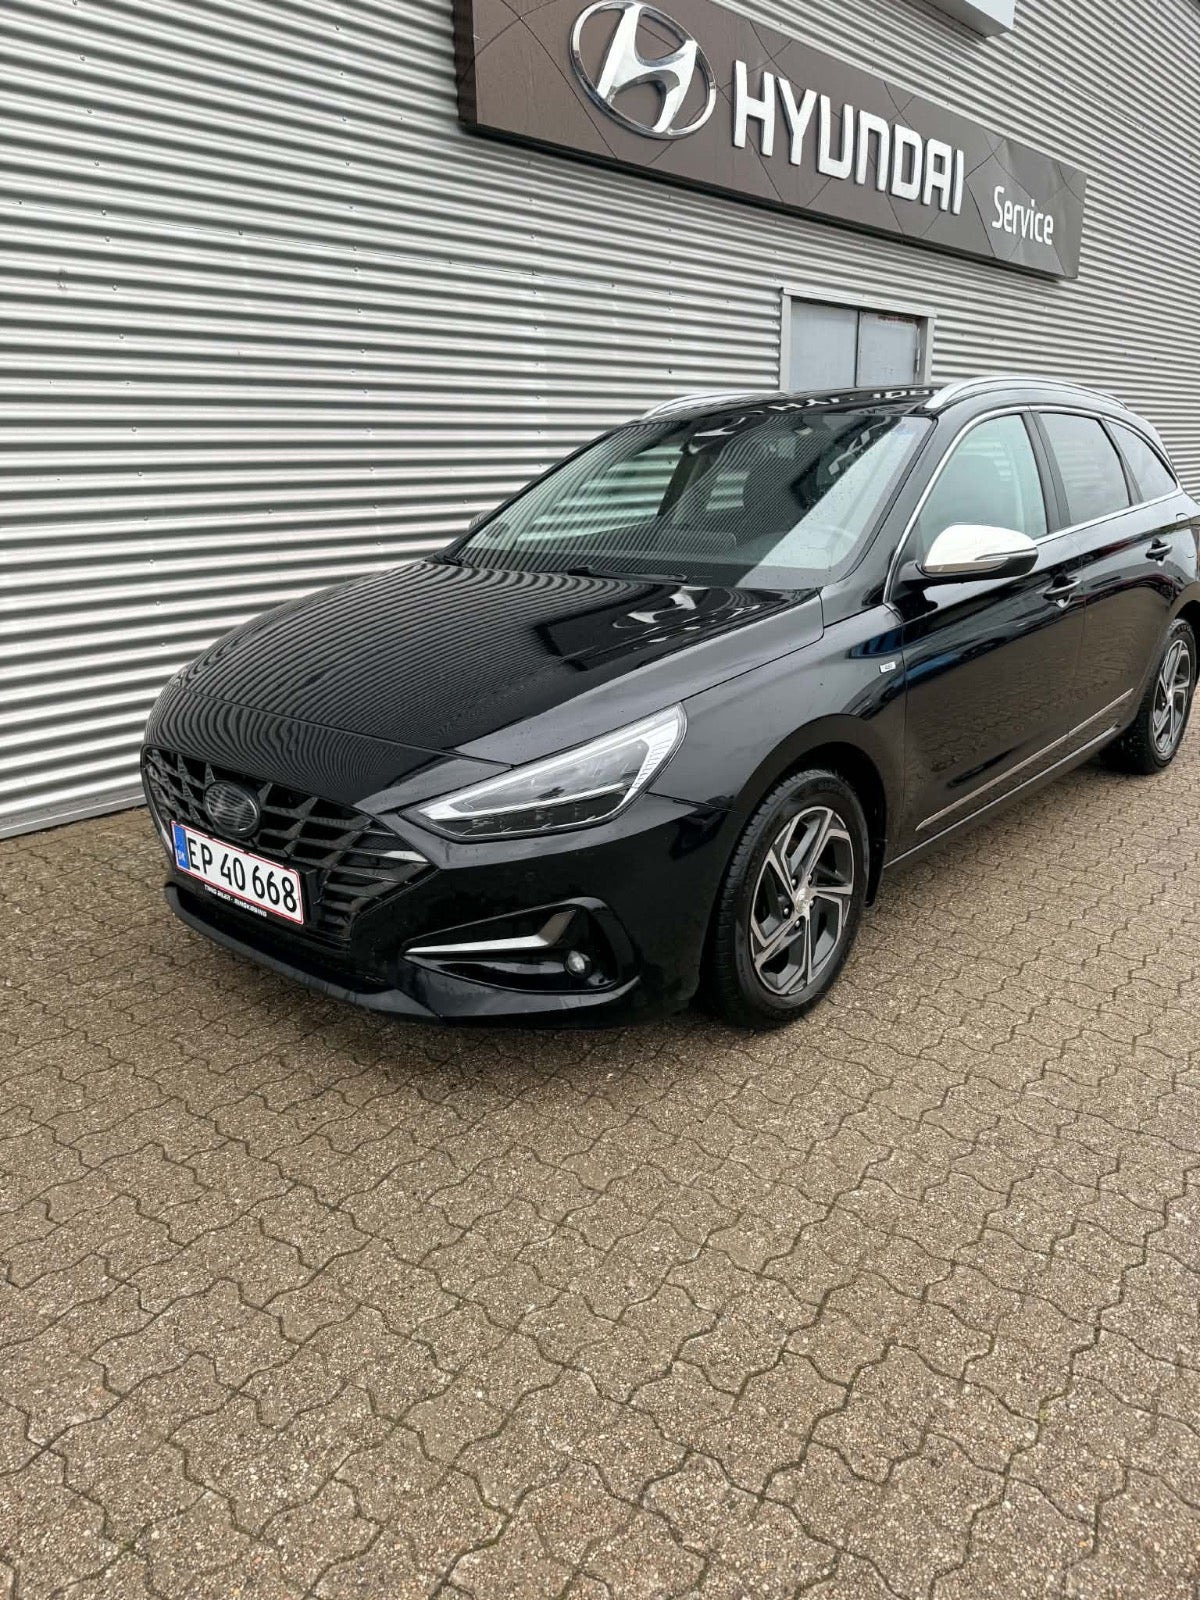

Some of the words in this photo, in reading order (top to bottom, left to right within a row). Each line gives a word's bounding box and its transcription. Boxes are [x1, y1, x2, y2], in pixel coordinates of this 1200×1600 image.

[733, 60, 965, 215] HYUNDAI
[991, 185, 1054, 246] Service
[187, 837, 213, 875] EP
[220, 853, 246, 891] 40
[252, 865, 297, 913] 668
